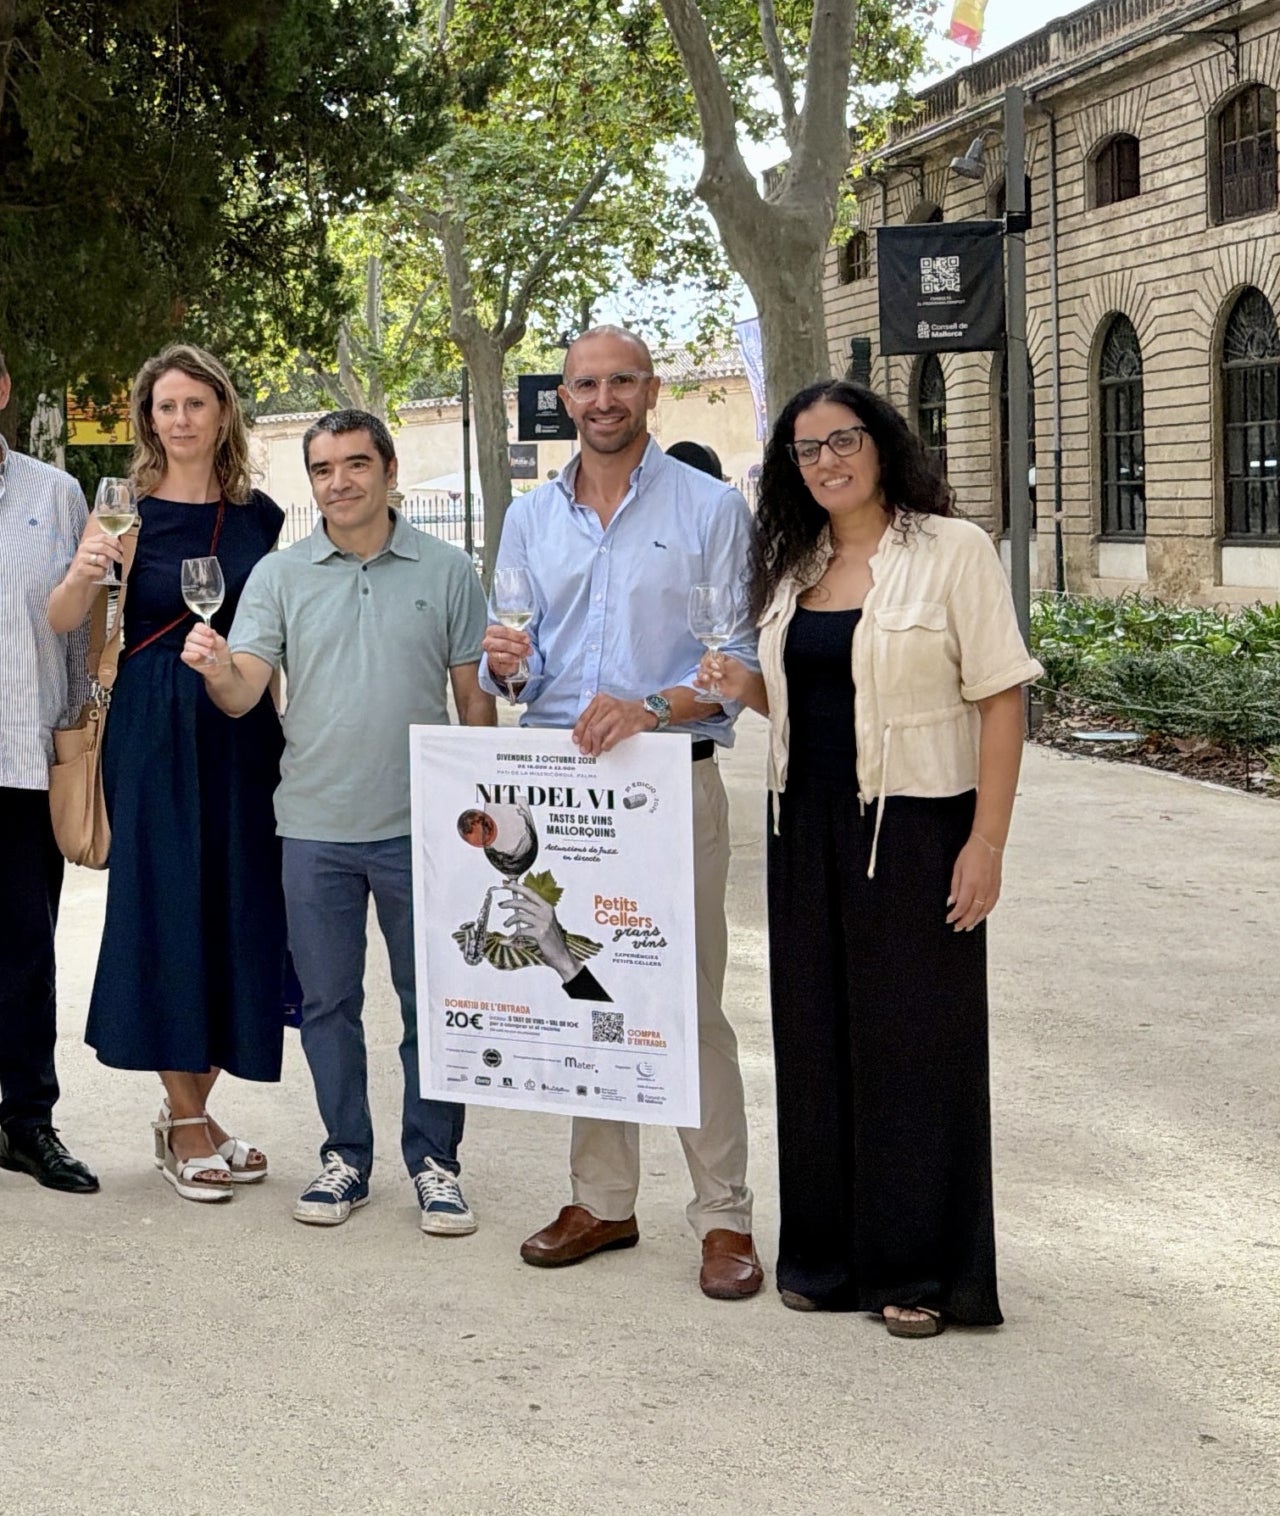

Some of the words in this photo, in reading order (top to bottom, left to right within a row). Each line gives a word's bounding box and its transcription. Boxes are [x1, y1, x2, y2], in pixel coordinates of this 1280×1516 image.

[496, 754, 532, 762] DIVENDRES
[542, 755, 576, 764] OCTUBRE
[476, 783, 520, 804] NIT
[528, 786, 582, 808] DEL
[587, 788, 616, 810] VI
[549, 814, 575, 824] TASTS
[578, 815, 589, 824] DE
[591, 816, 612, 826] VINS
[546, 825, 616, 838] MALLORQUINS
[594, 895, 638, 912] Petits
[594, 910, 652, 928] Cellers
[612, 926, 661, 942] grans
[632, 937, 668, 949] vins
[445, 1000, 478, 1009] DONATIU
[490, 1004, 530, 1014] L'ENTRADA
[446, 1010, 483, 1030] 20€
[628, 1029, 660, 1038] COMPRA
[628, 1038, 666, 1048] D'ENTRADES
